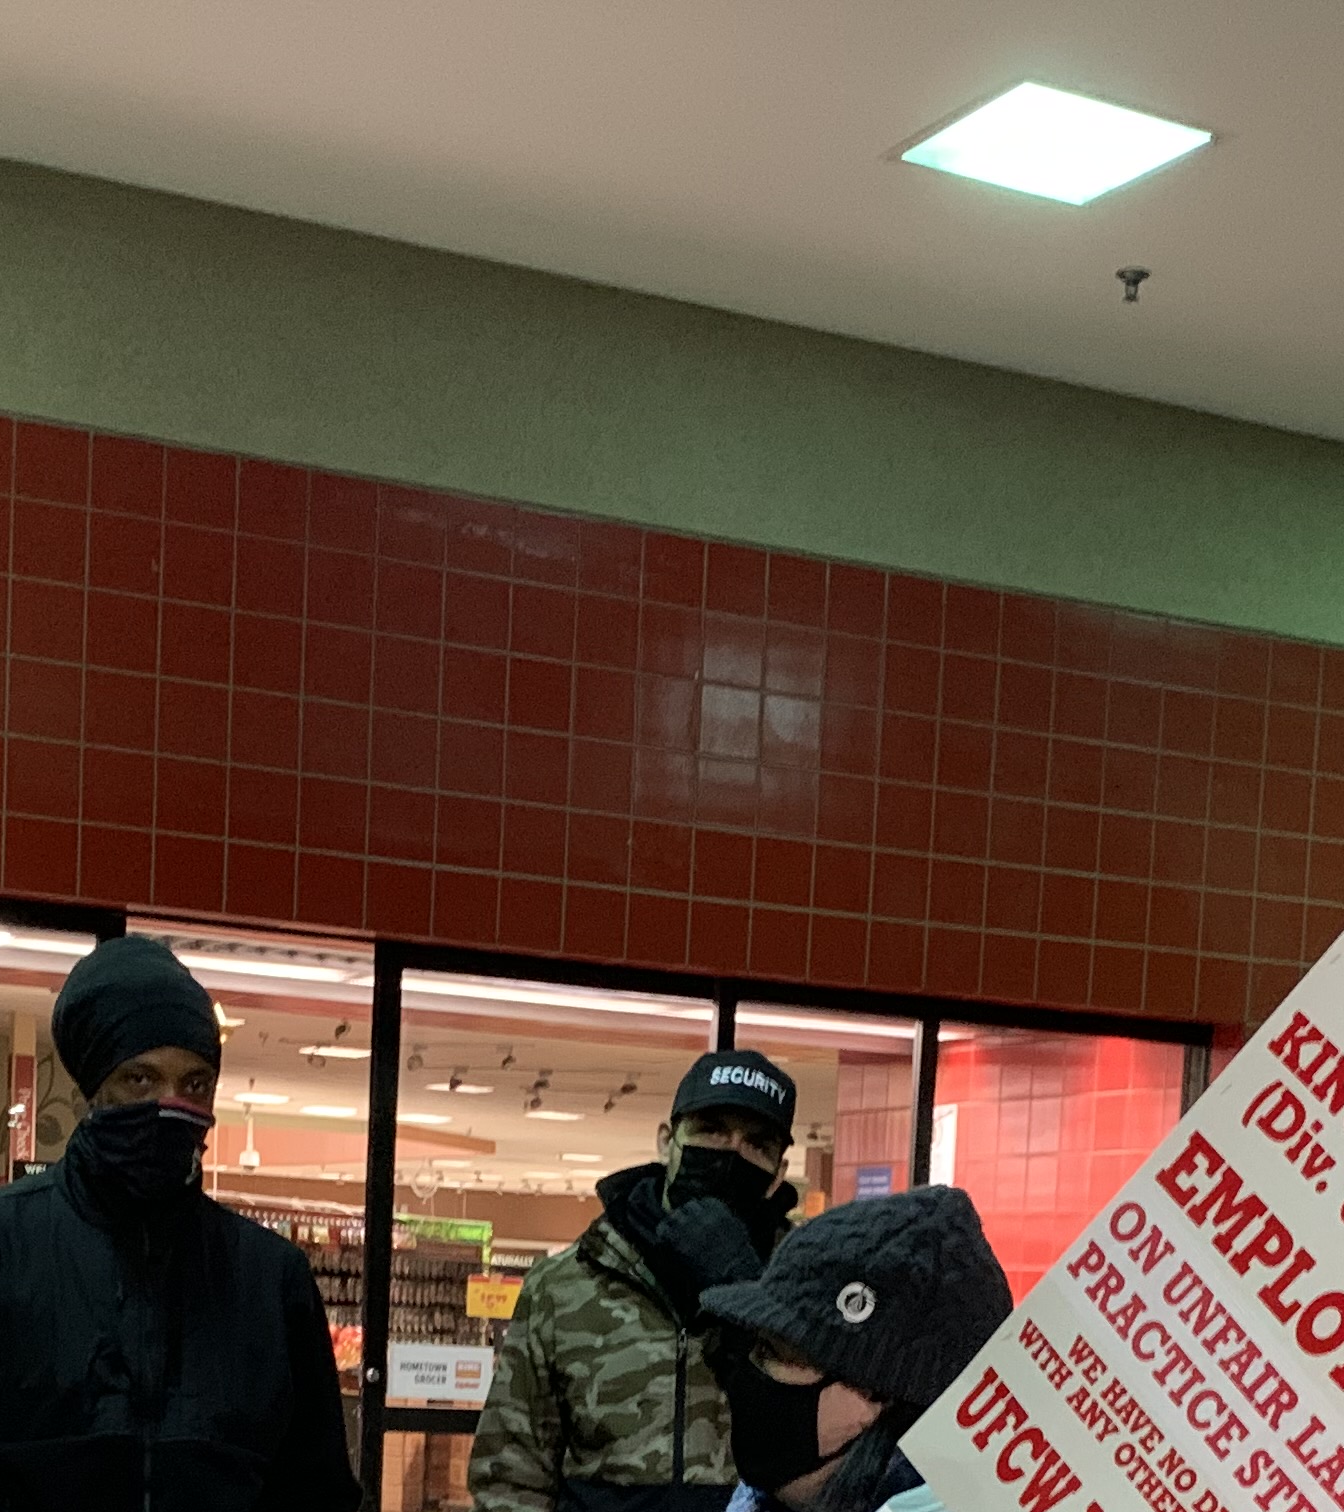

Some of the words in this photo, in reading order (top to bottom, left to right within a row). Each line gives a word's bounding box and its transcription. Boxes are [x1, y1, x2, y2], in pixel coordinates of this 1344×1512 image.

[709, 1065, 787, 1105] SECURITY
[1241, 1079, 1336, 1192] (Div.
[399, 1361, 448, 1374] HOMETOWN
[1067, 1241, 1249, 1460] PRACTICE
[1109, 1201, 1175, 1274] ON
[1162, 1261, 1298, 1430] UNFAIR
[414, 1373, 447, 1386] GROCER
[1019, 1319, 1073, 1389] WITH
[1066, 1386, 1118, 1441] ANY
[1068, 1335, 1107, 1384] WE
[1100, 1378, 1164, 1453] HAVE
[1157, 1448, 1197, 1492] NO
